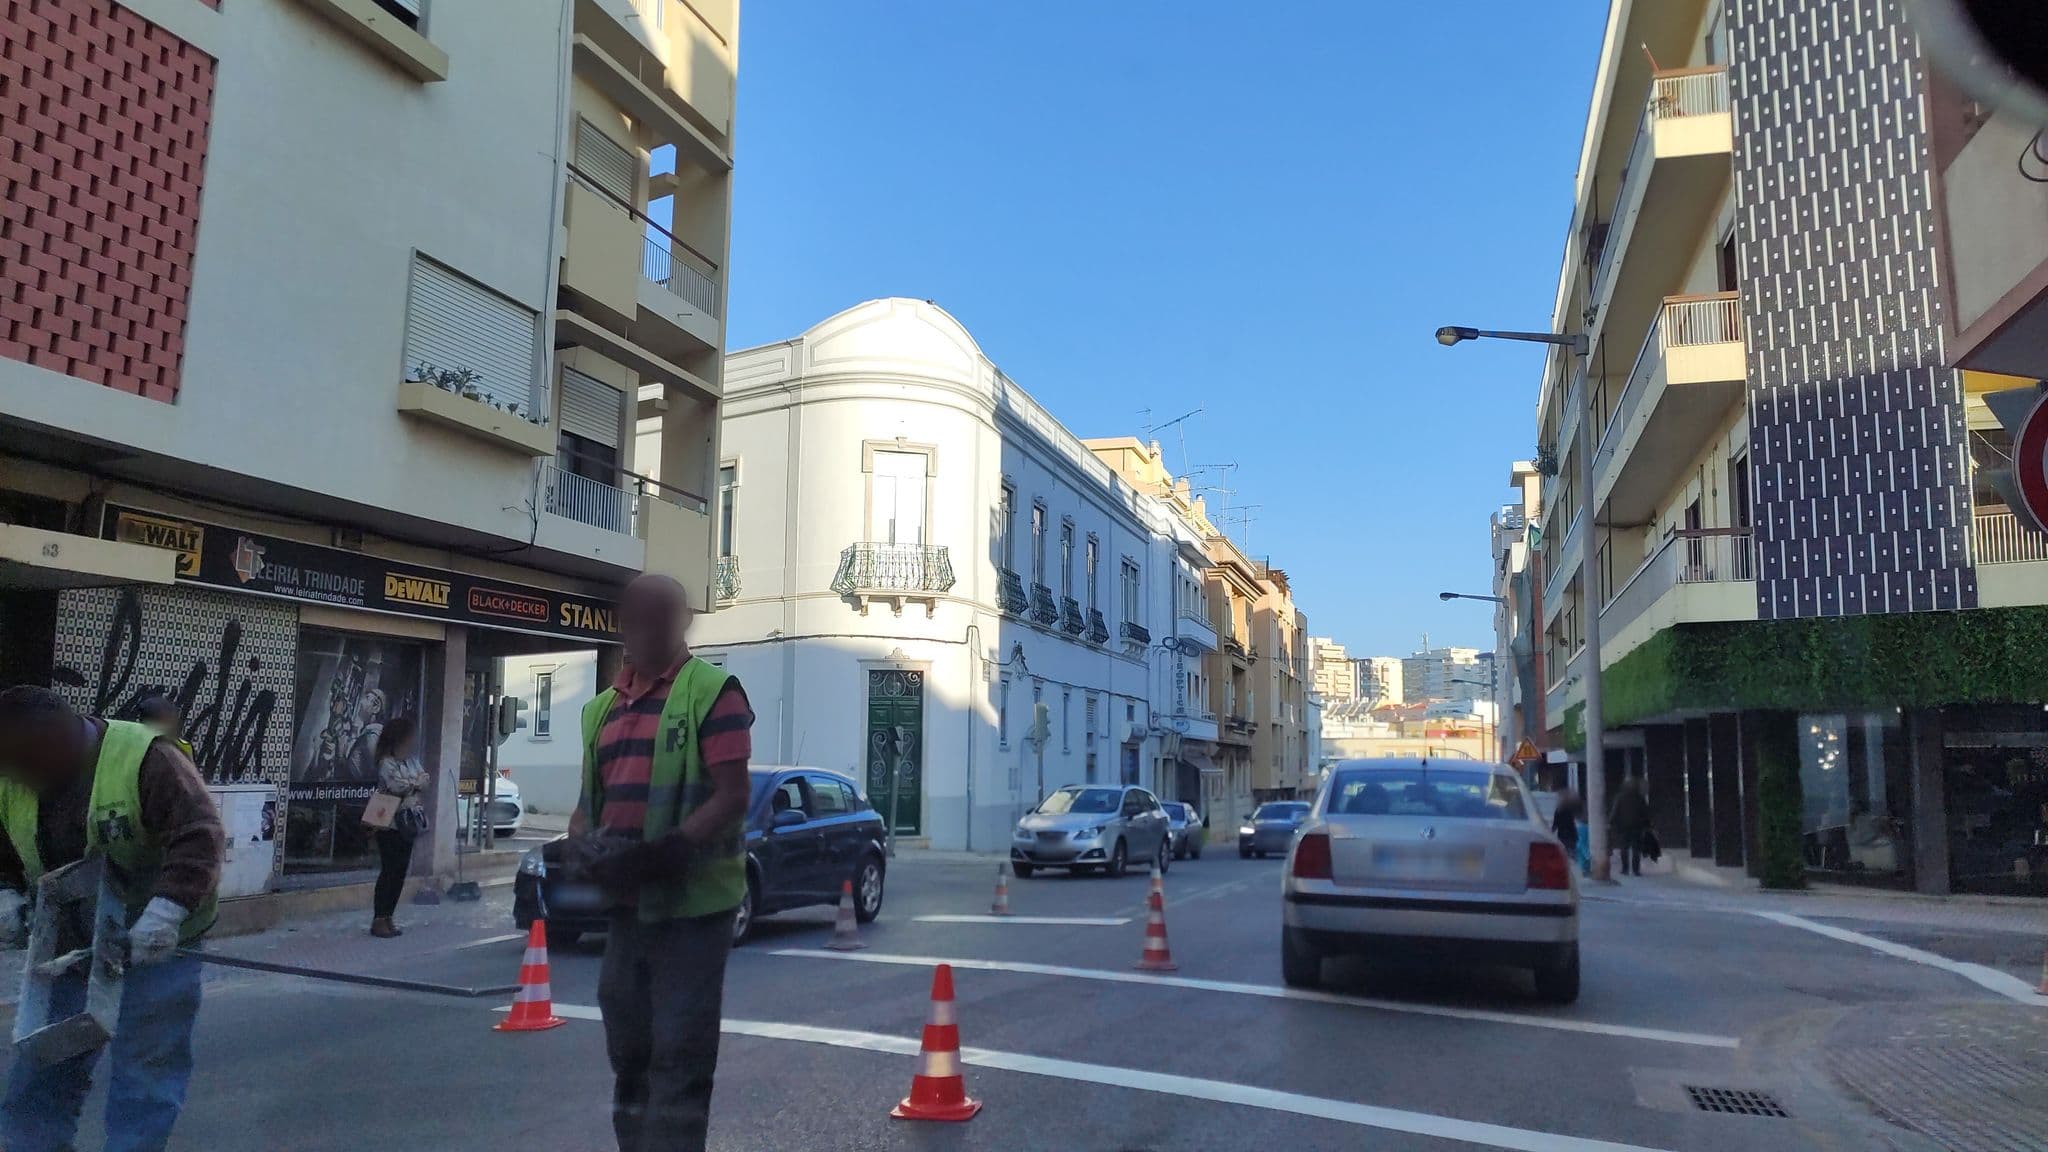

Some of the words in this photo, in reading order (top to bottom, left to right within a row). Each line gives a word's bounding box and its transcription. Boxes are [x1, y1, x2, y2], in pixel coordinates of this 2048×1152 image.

[145, 524, 200, 550] WALT
[274, 584, 364, 606] www.leiriatrindade.com
[304, 569, 366, 596] TRINDADE
[472, 594, 547, 616] BLACK+DECKER
[560, 602, 624, 633] STANL
